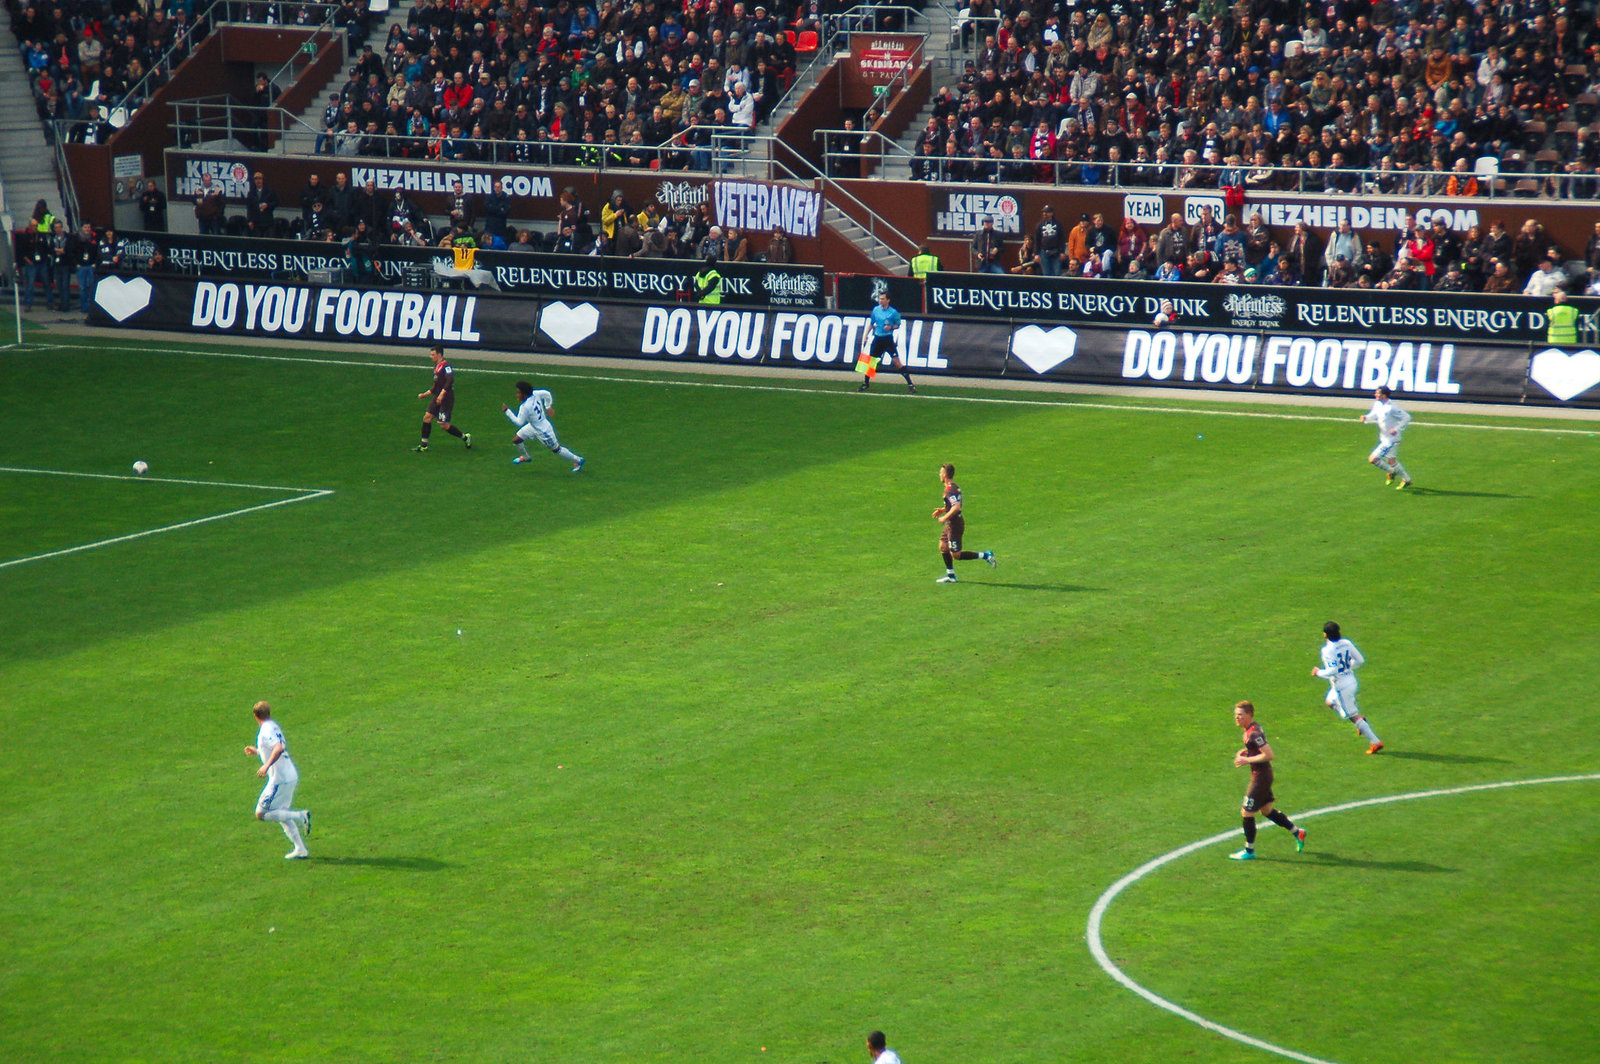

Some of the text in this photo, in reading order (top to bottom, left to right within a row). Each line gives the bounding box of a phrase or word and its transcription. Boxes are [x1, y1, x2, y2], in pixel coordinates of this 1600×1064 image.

[186, 160, 231, 178] KIEZ
[176, 177, 250, 198] HEDEN
[714, 181, 821, 237] VETERANEN
[949, 194, 999, 213] KIEZ
[1127, 202, 1160, 217] YEAH
[1187, 203, 1221, 219] ROR
[169, 248, 277, 271] RELENTLESS
[496, 266, 607, 288] RELENTLESS
[613, 272, 687, 295] ENERGY
[191, 281, 480, 342] DO YOU FOOTBALL
[769, 297, 793, 305] ENERGY
[933, 287, 1052, 310] RELENTLESS
[1058, 293, 1139, 317] ENERGY
[1231, 319, 1257, 327] ENERGY
[1297, 303, 1428, 327] RELENTLESS
[1433, 308, 1523, 333] ENERGY
[641, 307, 691, 355] DO
[697, 309, 766, 359] YOU
[1122, 330, 1460, 394] DO YOU FOOTBALL
